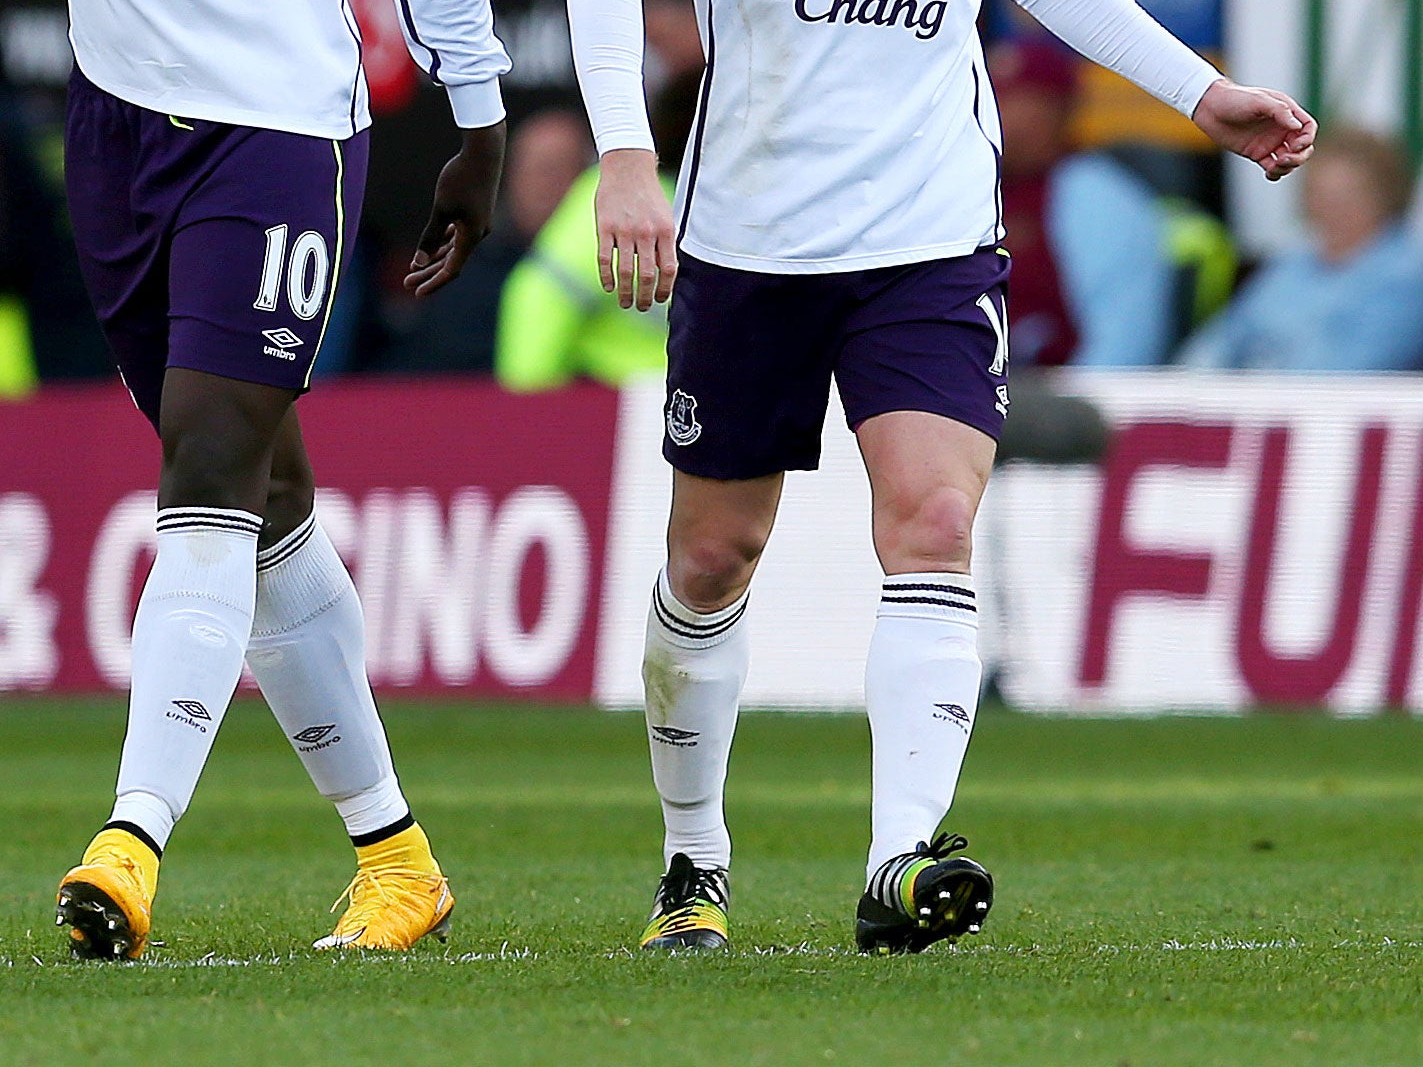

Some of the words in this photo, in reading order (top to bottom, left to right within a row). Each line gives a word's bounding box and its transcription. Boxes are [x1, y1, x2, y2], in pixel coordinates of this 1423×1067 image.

[253, 224, 329, 320] 10
[263, 345, 296, 361] umbro
[87, 485, 590, 690] CINO
[1076, 418, 1423, 710] FU
[165, 711, 207, 733] umbro
[299, 735, 342, 753] umbro
